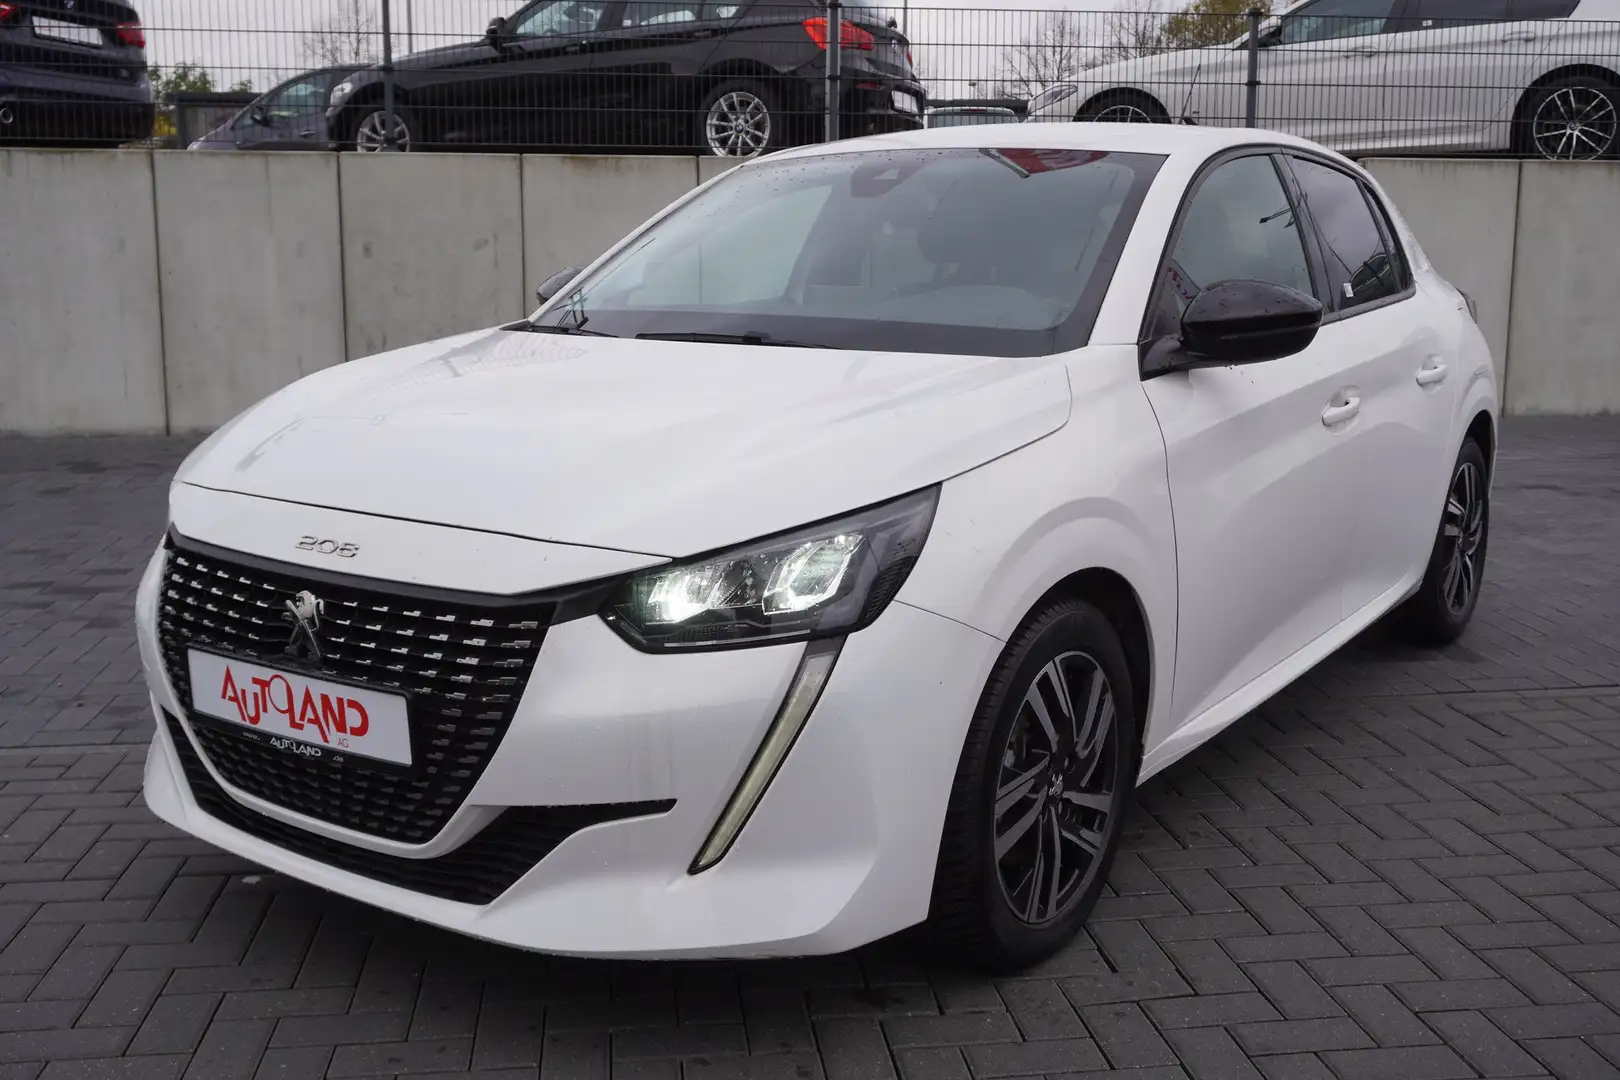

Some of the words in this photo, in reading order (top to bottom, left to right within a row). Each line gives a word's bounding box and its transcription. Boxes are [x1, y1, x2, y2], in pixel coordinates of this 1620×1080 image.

[295, 535, 360, 558] 208
[221, 665, 369, 743] AUTOLAND
[269, 737, 322, 757] AUTOLAND
[337, 737, 349, 749] AG
